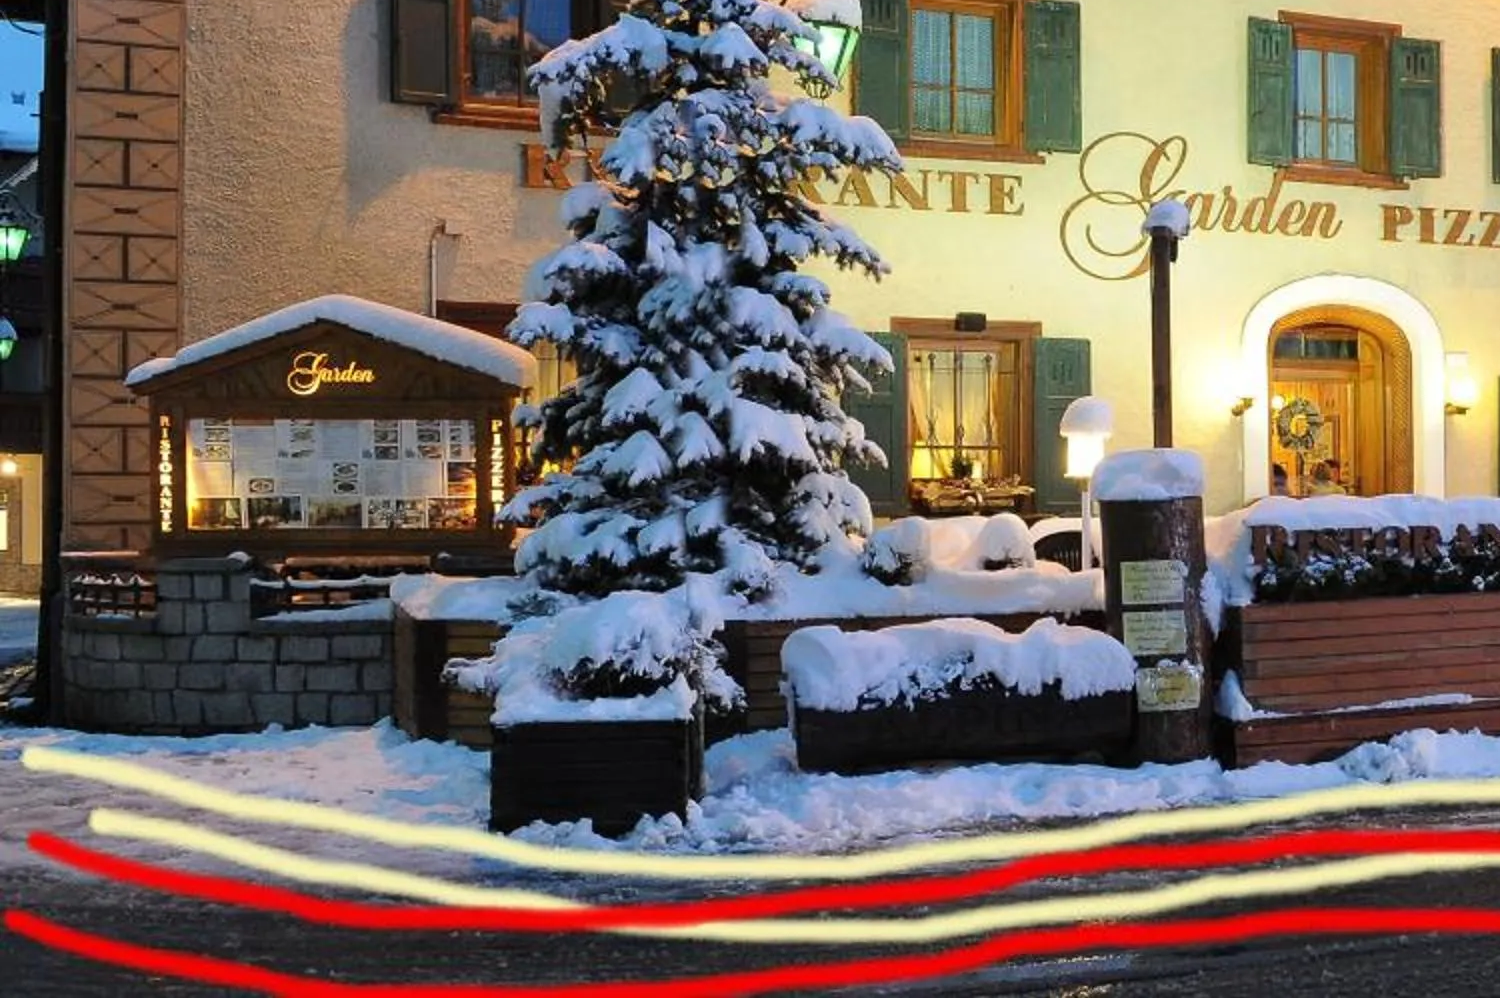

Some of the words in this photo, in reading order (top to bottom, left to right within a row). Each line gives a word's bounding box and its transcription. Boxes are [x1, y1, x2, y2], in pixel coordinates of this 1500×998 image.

[1060, 131, 1343, 281] Garden
[287, 352, 375, 396] Garden
[159, 415, 172, 532] RISTORANTE
[491, 419, 504, 530] PIZZERI
